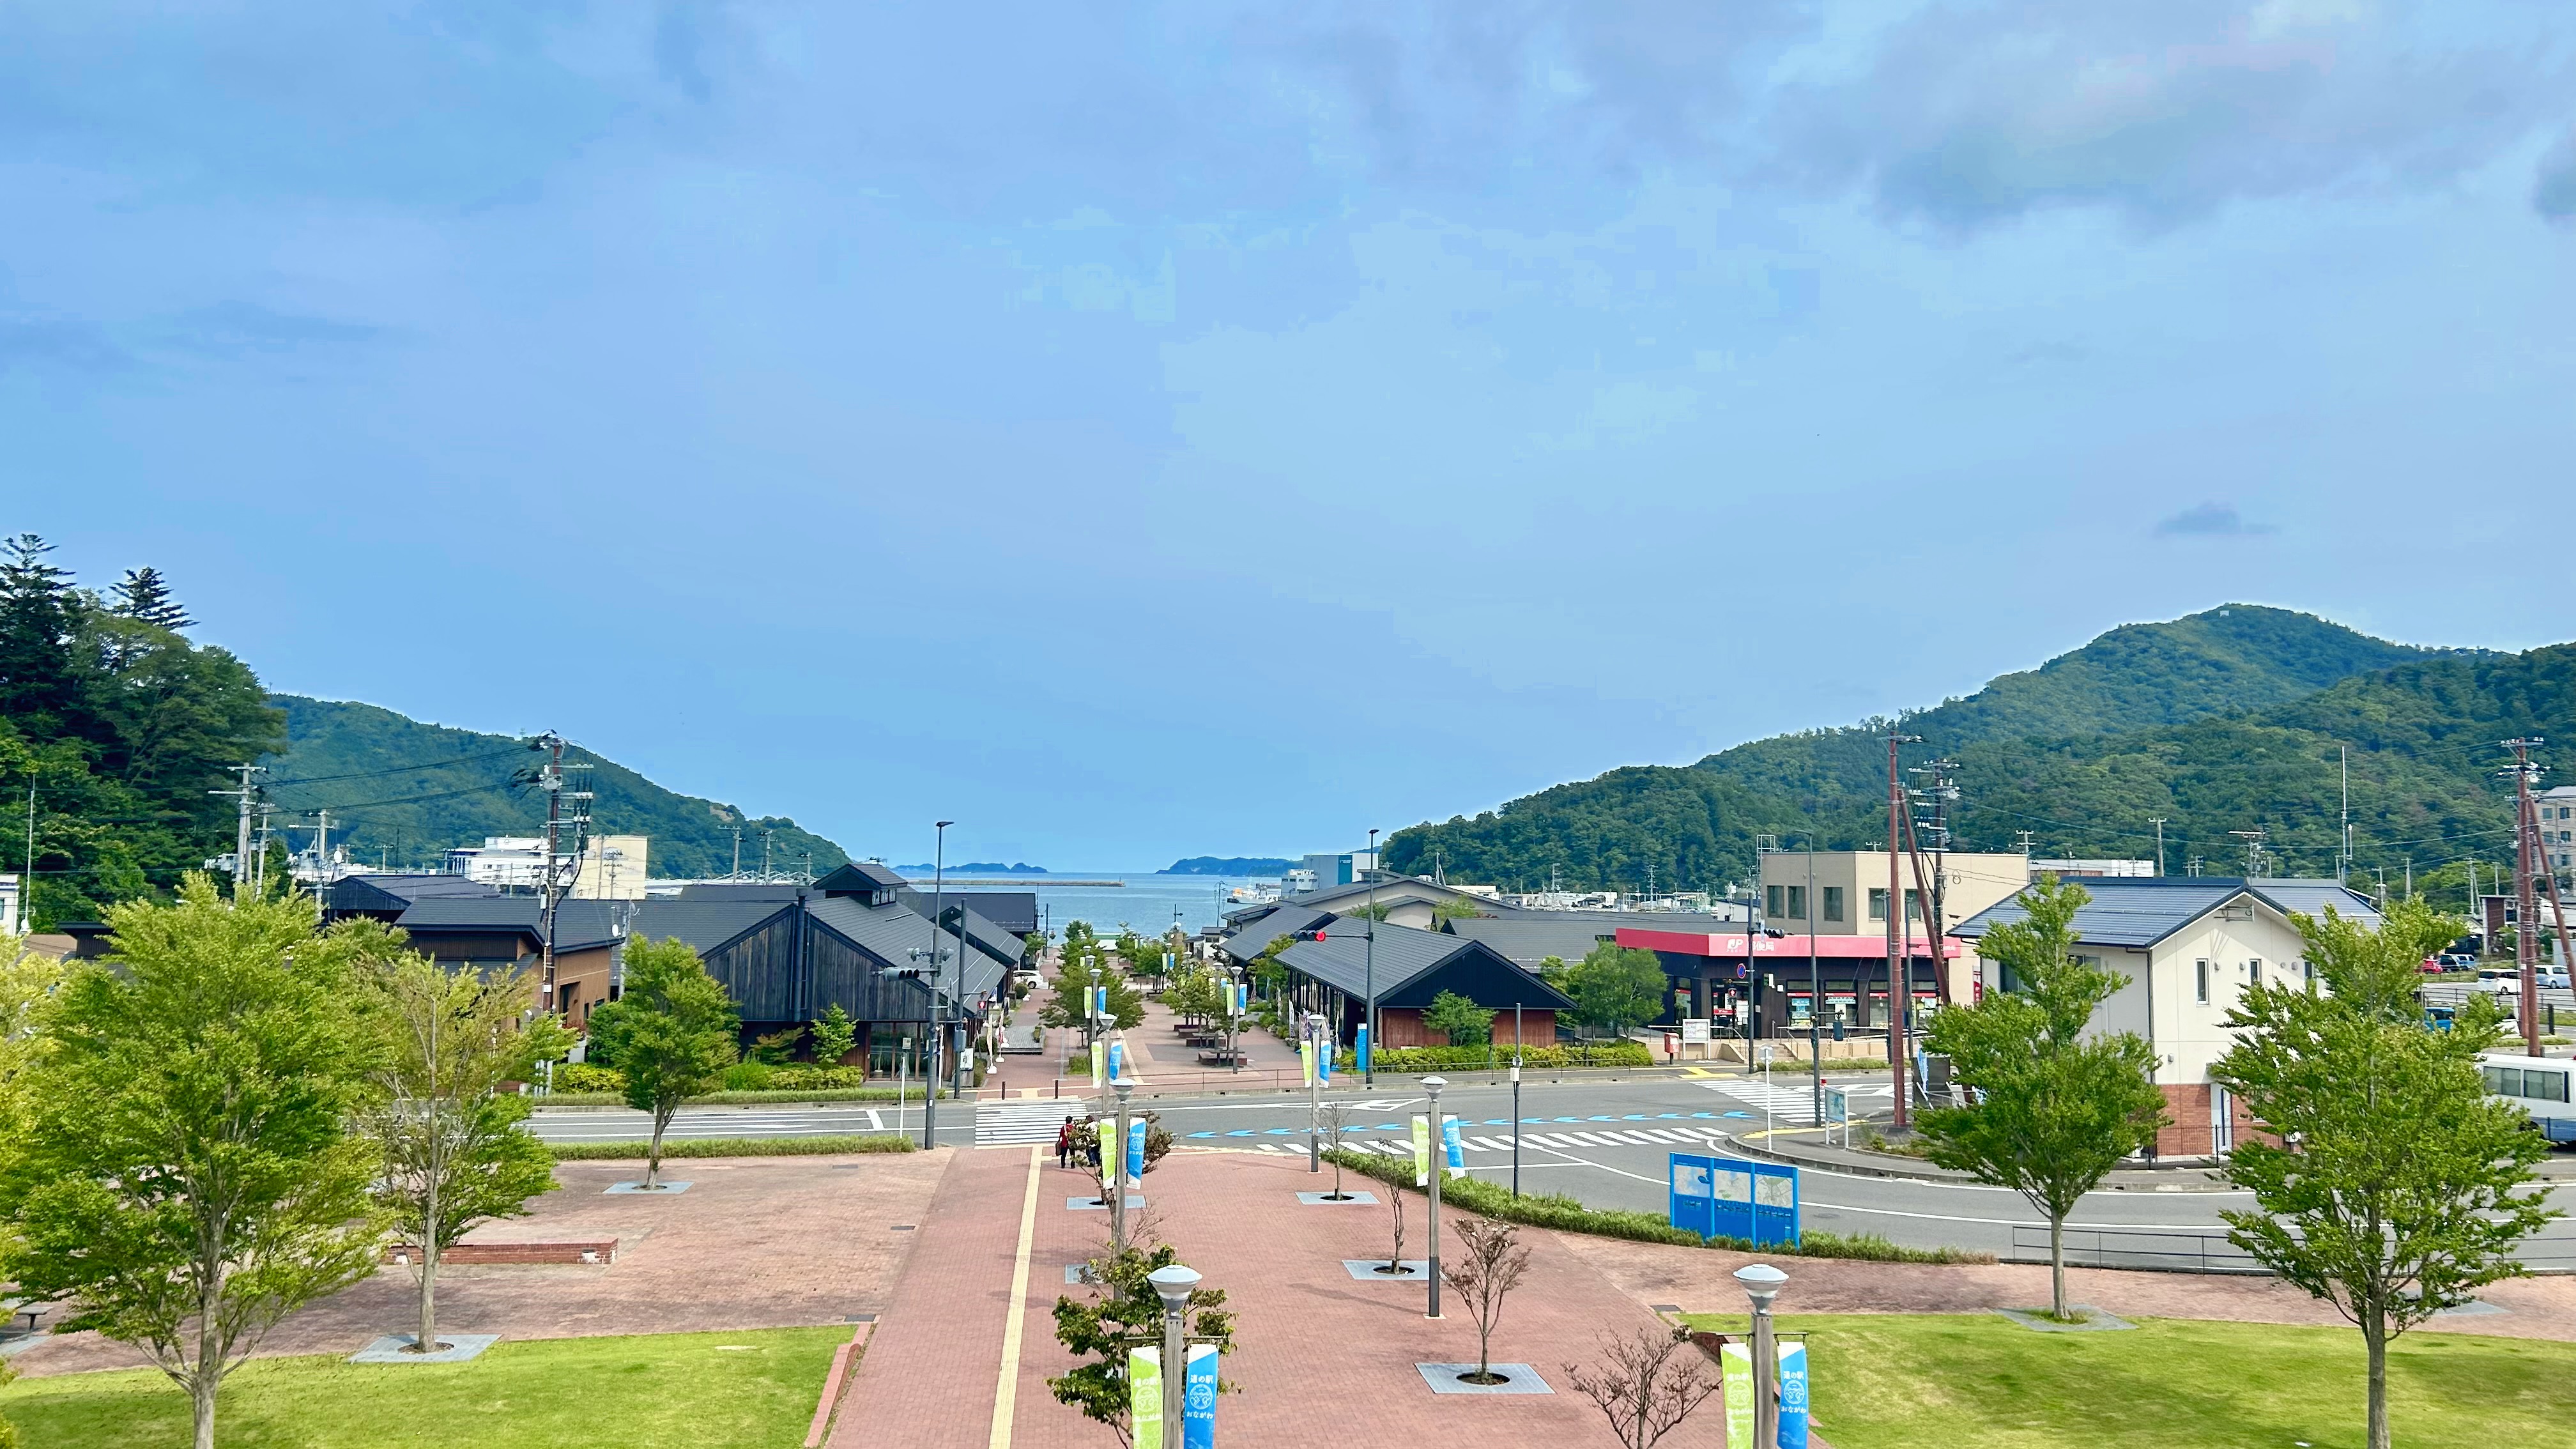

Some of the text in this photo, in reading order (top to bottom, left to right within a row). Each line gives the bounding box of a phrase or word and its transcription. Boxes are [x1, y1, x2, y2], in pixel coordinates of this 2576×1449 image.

[1190, 1374, 1214, 1384] 道の駅
[1784, 1370, 1805, 1380] 道の駅
[1781, 1406, 1807, 1414] おながわ
[1186, 1411, 1214, 1420] おながわ
